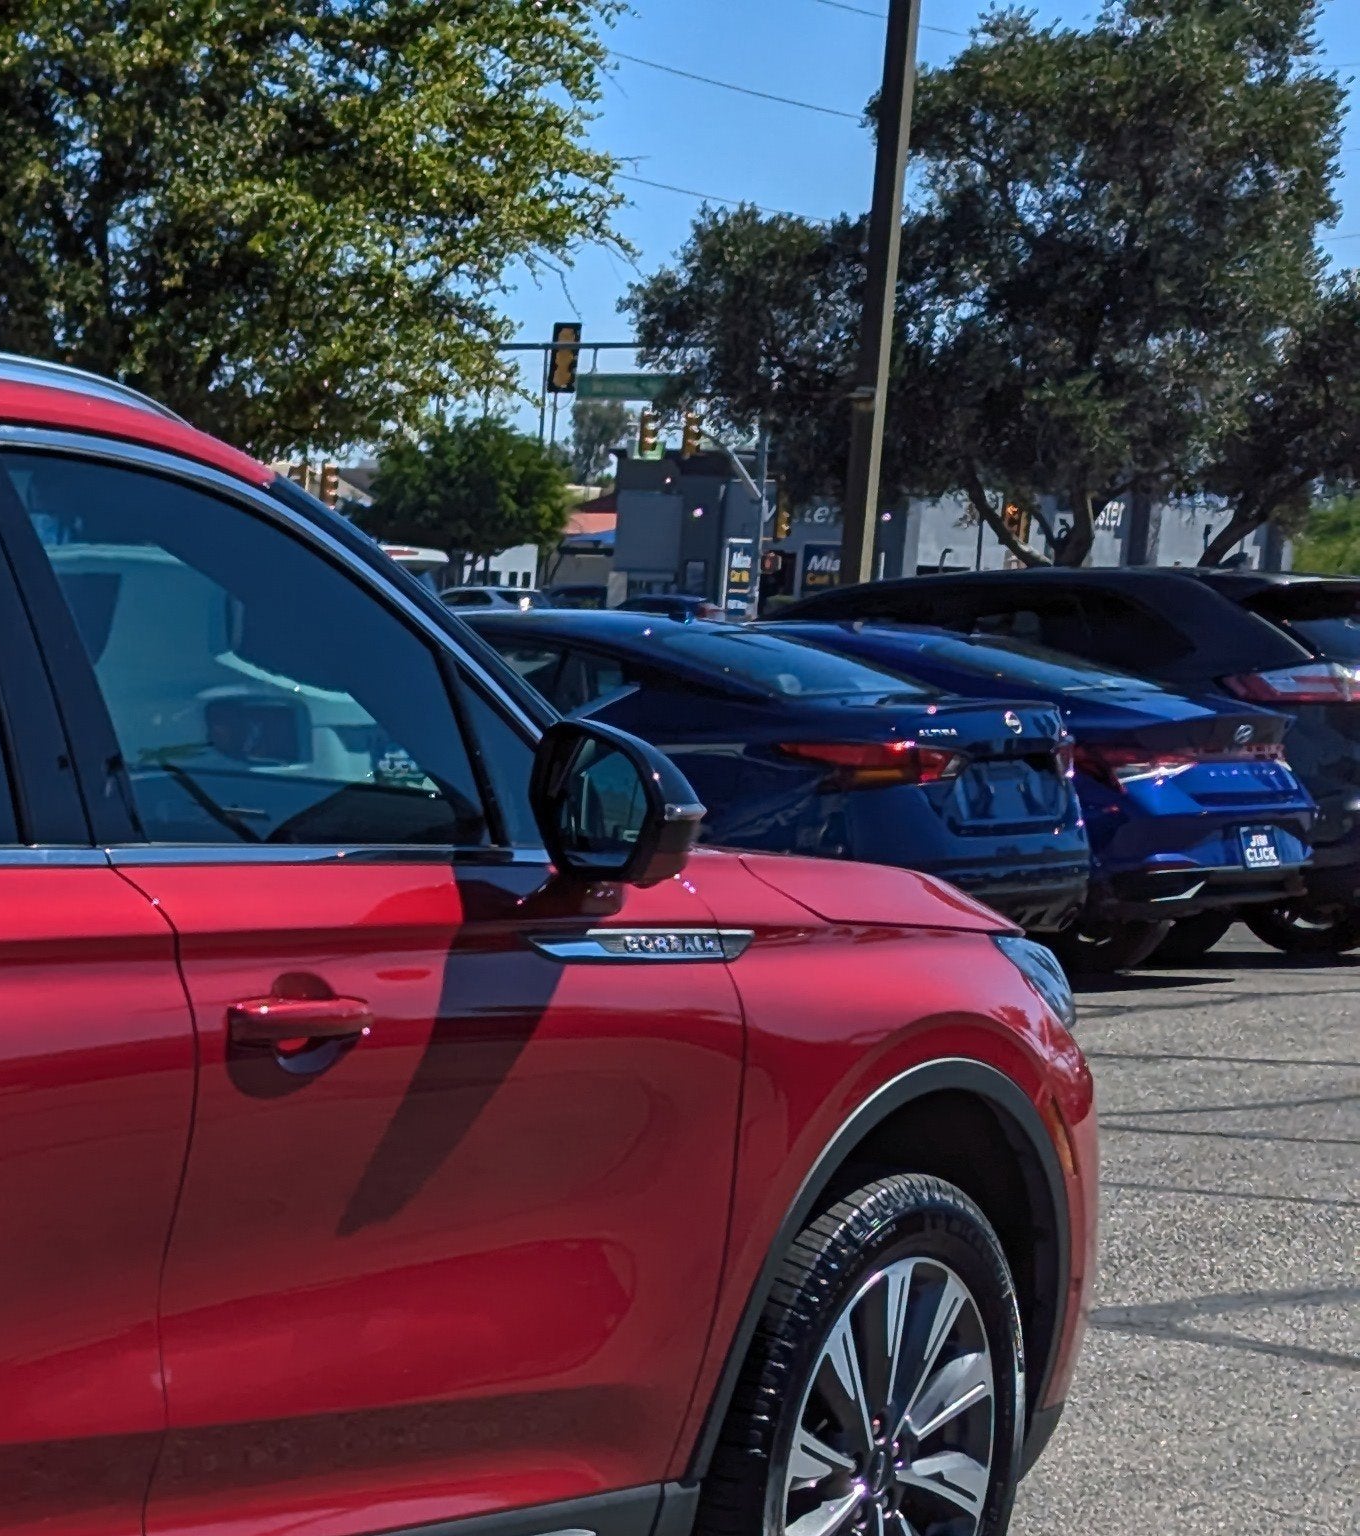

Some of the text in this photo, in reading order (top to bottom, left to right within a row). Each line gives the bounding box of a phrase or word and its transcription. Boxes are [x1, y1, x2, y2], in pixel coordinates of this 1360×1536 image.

[1249, 834, 1269, 847] JIM
[1245, 846, 1278, 862] CLICK
[622, 935, 715, 953] CORSAIR
